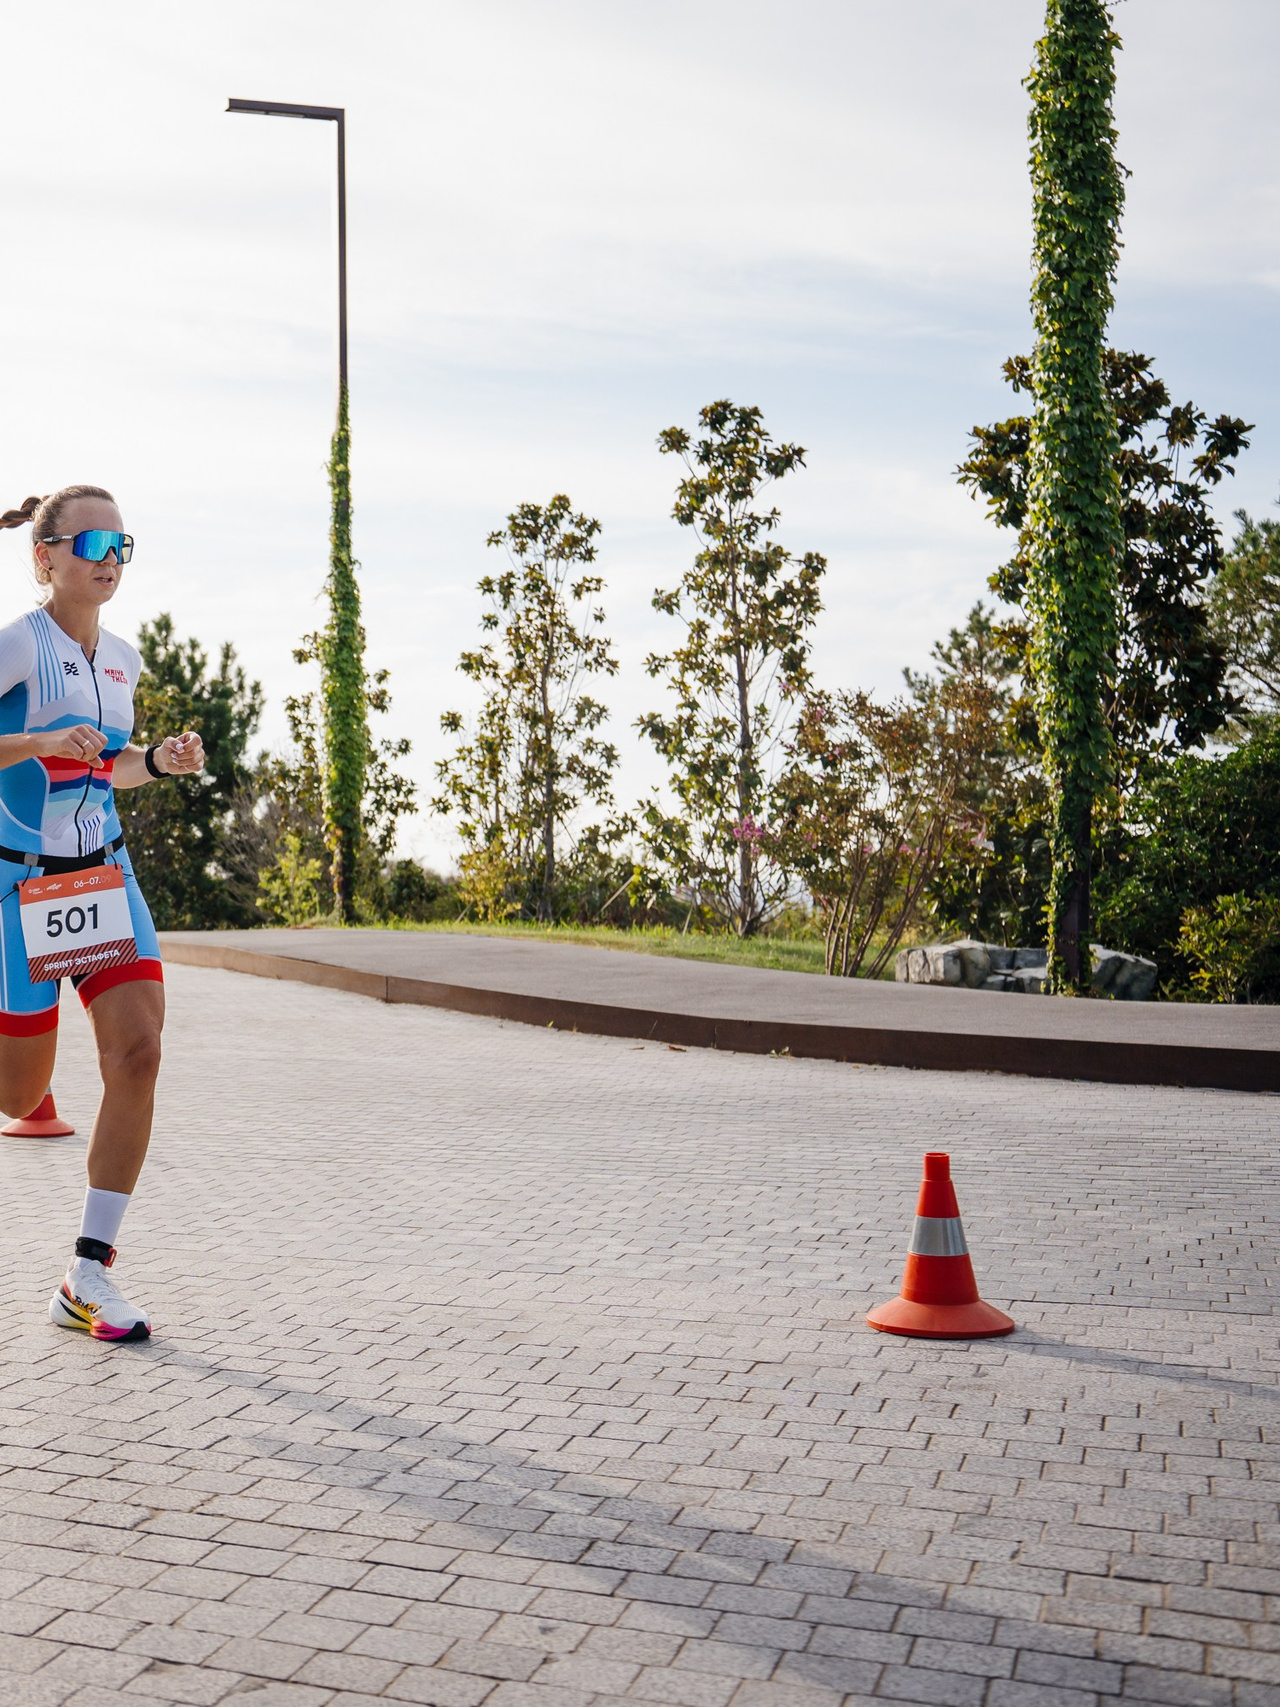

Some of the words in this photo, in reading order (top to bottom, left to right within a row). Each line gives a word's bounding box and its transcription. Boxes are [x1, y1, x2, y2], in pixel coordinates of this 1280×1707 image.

[46, 903, 98, 938] 501
[43, 959, 74, 972] SPRINT
[74, 949, 120, 966] ЭСТАФЕТА
